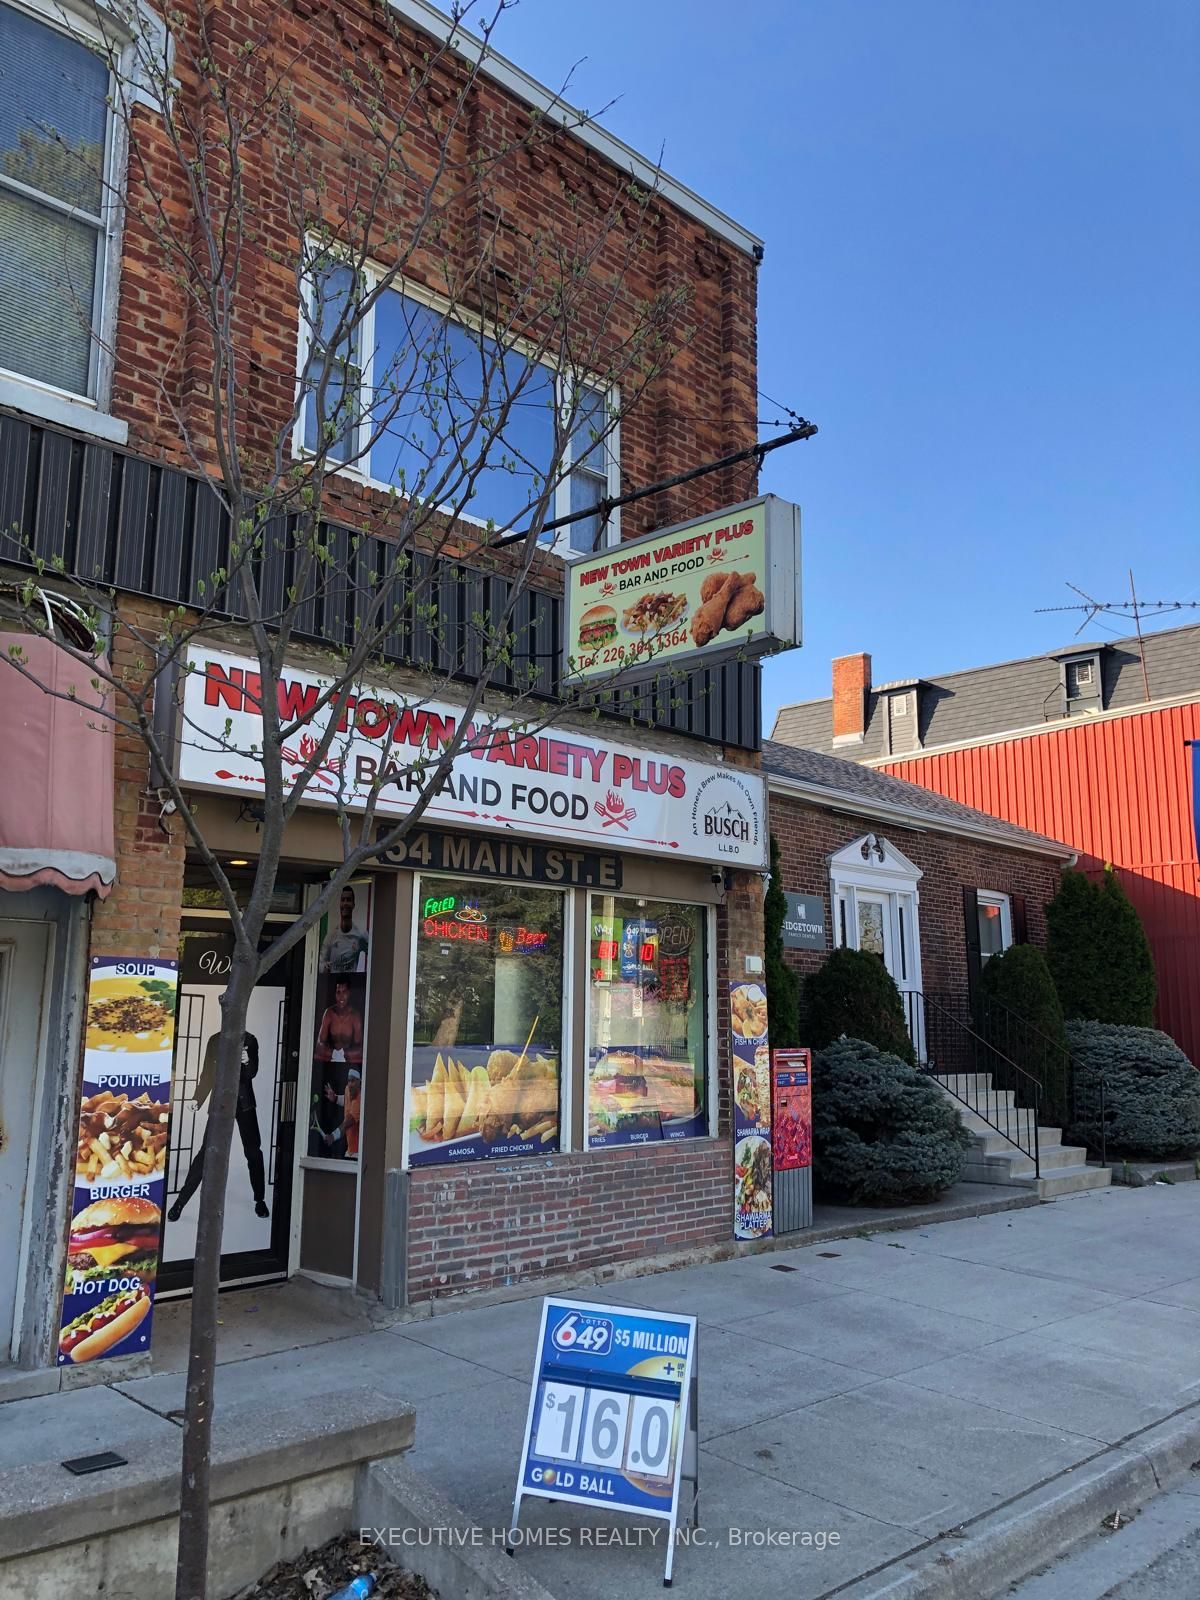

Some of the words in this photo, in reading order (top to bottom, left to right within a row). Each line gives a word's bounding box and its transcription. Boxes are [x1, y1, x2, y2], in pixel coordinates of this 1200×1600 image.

[579, 565, 609, 587] NEW
[611, 552, 650, 575] TOWN
[653, 532, 714, 564] VARIETY
[715, 519, 754, 545] PLUS
[619, 574, 642, 591] BAR
[644, 567, 669, 584] AND
[671, 556, 705, 577] FOOD
[578, 654, 599, 669] Tel:
[603, 646, 625, 663] 226
[657, 629, 688, 650] 1364
[204, 662, 321, 725] NEW
[330, 692, 455, 750] TOWN
[463, 720, 608, 783] VARIETY
[613, 753, 686, 799] PLUS
[701, 774, 717, 789] Brew
[716, 772, 736, 783] Makes
[736, 779, 745, 790] Its
[355, 755, 426, 796] BAR
[433, 769, 501, 806] AND
[511, 784, 589, 820] FOOD
[691, 788, 703, 820] Honest
[744, 790, 755, 810] Own
[692, 823, 699, 836] An
[704, 814, 749, 841] BUSCH
[442, 835, 533, 878] MAIN
[545, 850, 593, 884] ST.
[600, 856, 616, 887] E
[425, 896, 455, 918] FRIED
[423, 919, 489, 941] CHICKEN
[515, 927, 548, 945] Beer
[115, 962, 155, 977] SOUP
[97, 1073, 160, 1089] POUTINE
[491, 1145, 509, 1154] FRIED
[509, 1143, 534, 1152] CHICKEN
[591, 1136, 606, 1144] FRIES
[448, 1147, 475, 1156] SAMOSA
[90, 1184, 150, 1200] BURGER
[736, 1212, 772, 1223] SHAWARMA
[740, 1219, 768, 1230] PLATTER
[72, 1279, 106, 1296] HOT
[108, 1277, 141, 1293] DOG
[581, 1318, 608, 1327] LOTTO
[615, 1328, 631, 1347] $5
[632, 1330, 688, 1355] MILLION
[579, 1475, 615, 1496] BALL
